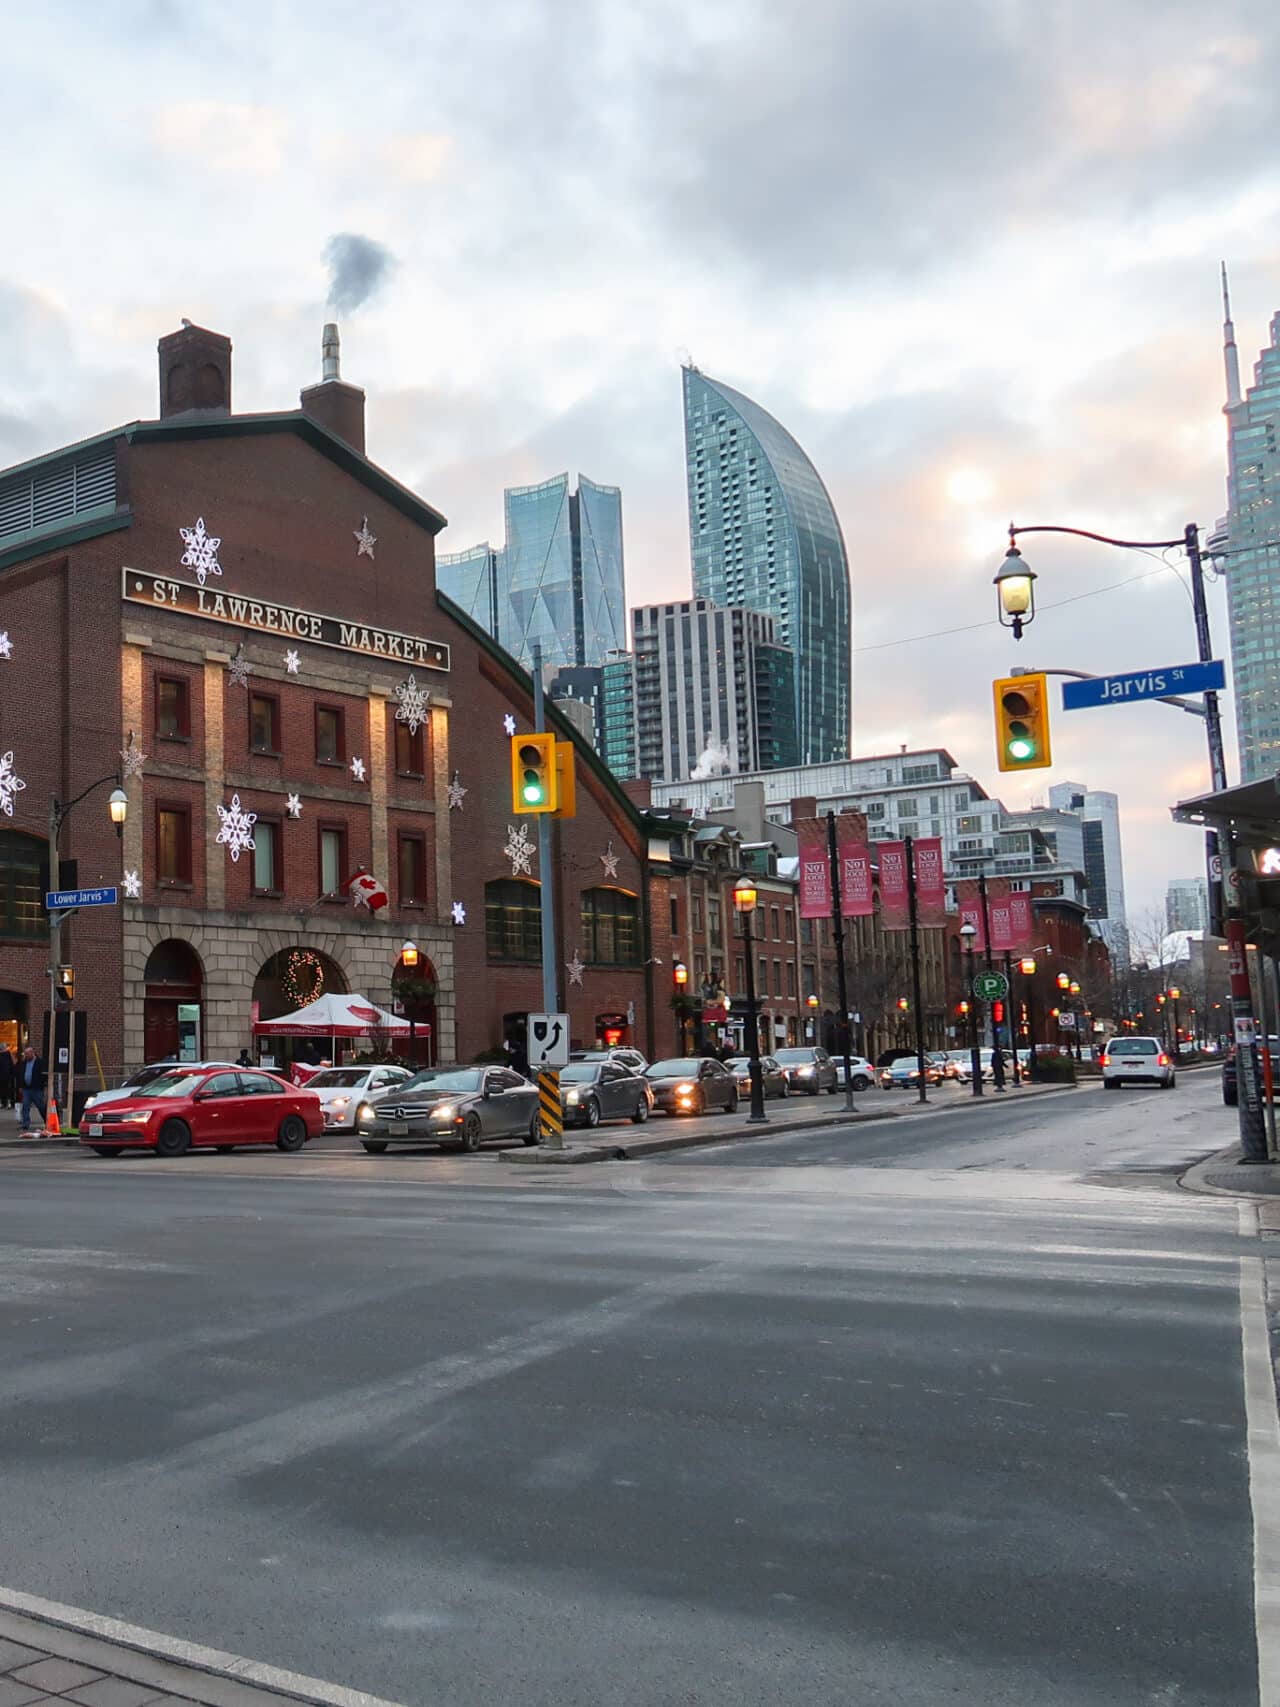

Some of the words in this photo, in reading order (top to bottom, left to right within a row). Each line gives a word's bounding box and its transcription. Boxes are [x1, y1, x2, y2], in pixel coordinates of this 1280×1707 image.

[198, 590, 322, 639] LAWRENCE
[340, 624, 427, 662] MARKET
[1100, 673, 1166, 699] Jarvis
[1172, 669, 1185, 680] St
[54, 894, 77, 904] Lower
[79, 890, 102, 903] Jarvis
[984, 979, 997, 992] P
